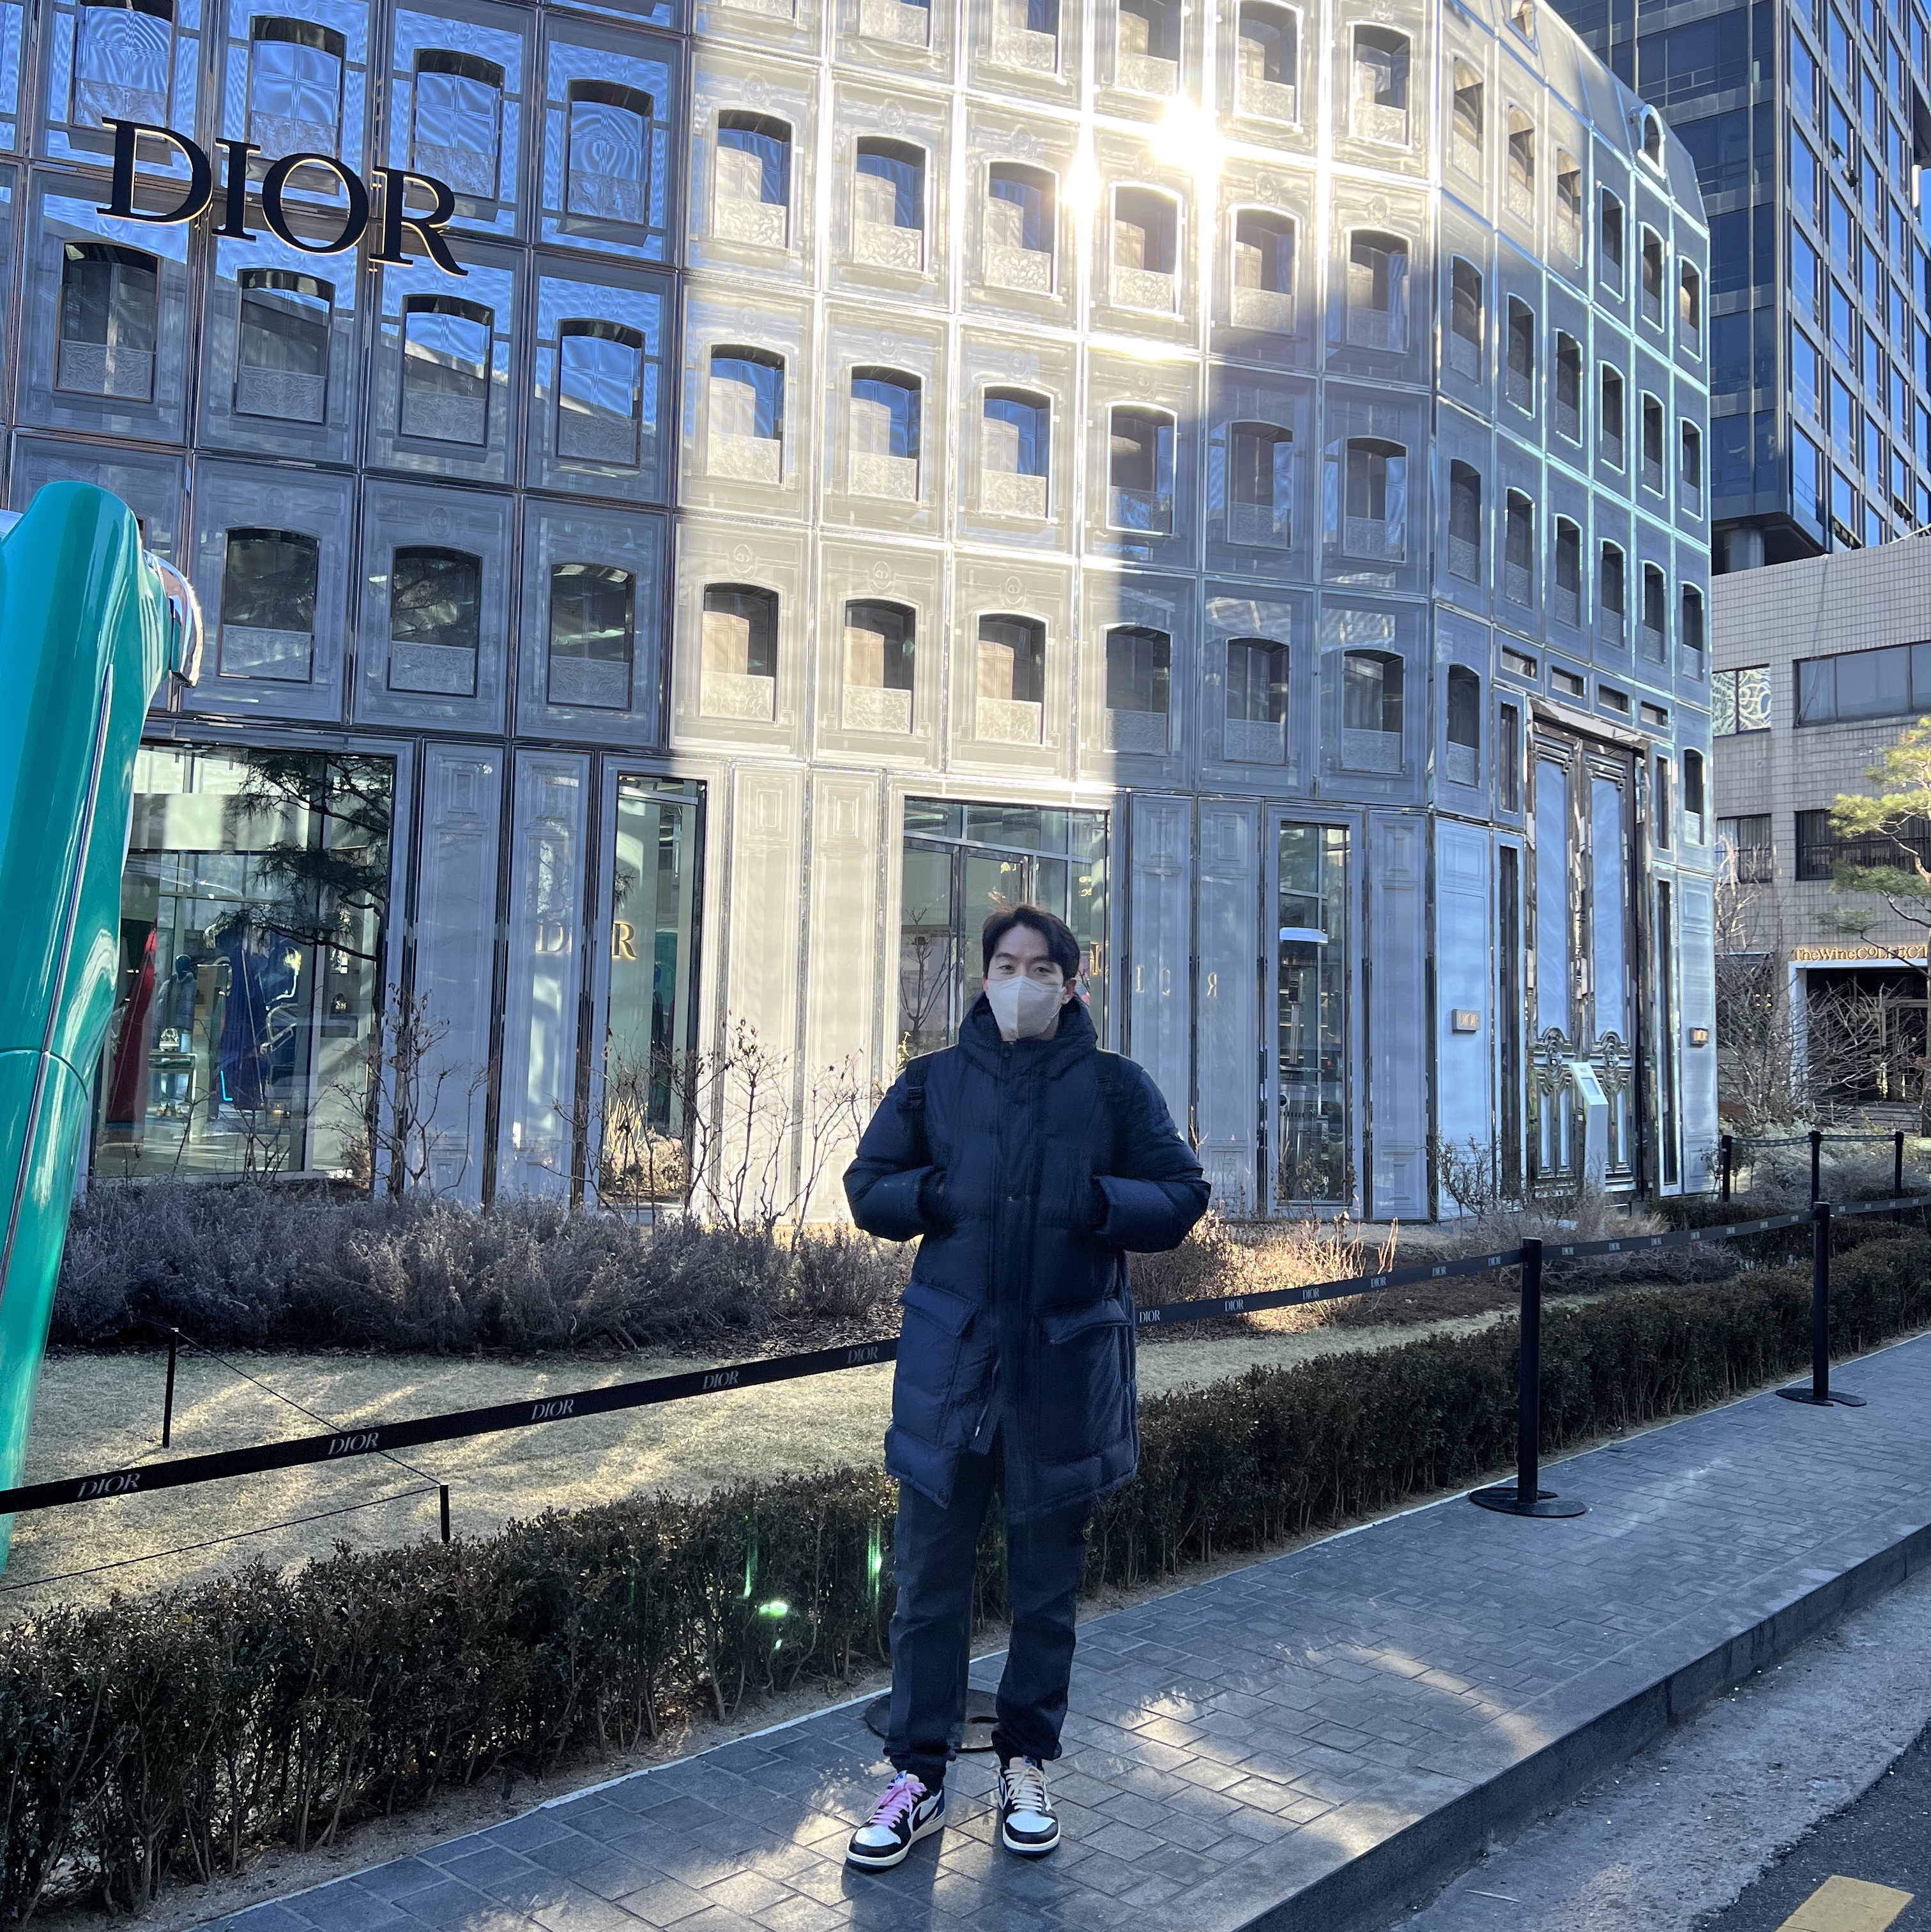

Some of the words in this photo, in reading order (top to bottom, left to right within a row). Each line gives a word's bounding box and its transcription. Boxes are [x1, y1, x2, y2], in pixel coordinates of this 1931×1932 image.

[96, 116, 469, 277] DIOR
[1432, 1265, 1446, 1277] DIOR
[1371, 1276, 1387, 1288] DIOR
[1302, 1288, 1320, 1300] DIOR
[1225, 1299, 1244, 1312] DIOR
[1139, 1309, 1161, 1323] DIOR
[847, 1346, 879, 1364] DIOR
[703, 1370, 739, 1390] DIOR
[530, 1398, 574, 1421] DIOR
[329, 1433, 379, 1455] DIOR
[77, 1473, 140, 1498] DIOR
